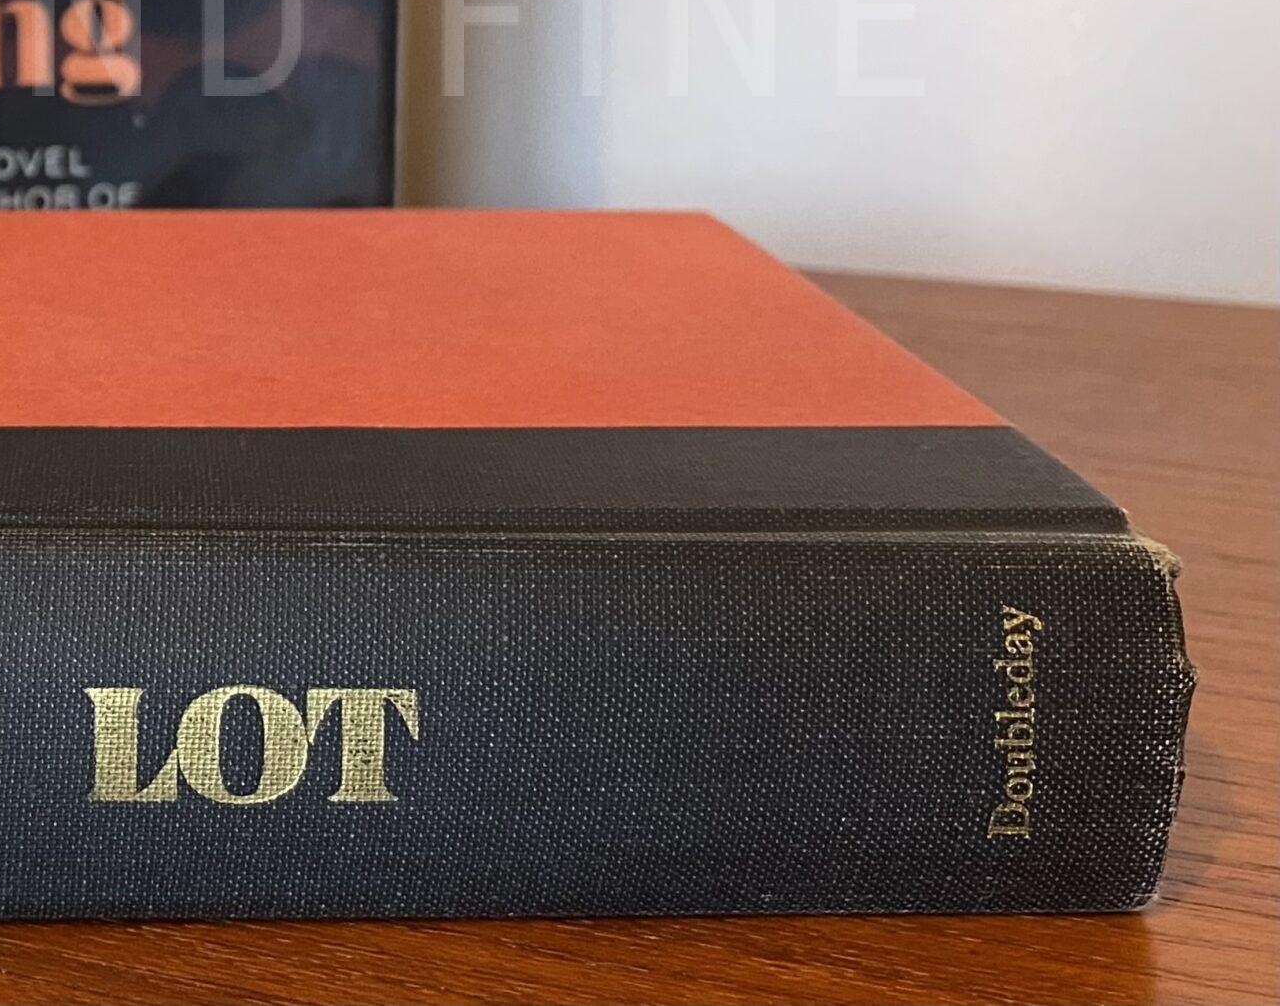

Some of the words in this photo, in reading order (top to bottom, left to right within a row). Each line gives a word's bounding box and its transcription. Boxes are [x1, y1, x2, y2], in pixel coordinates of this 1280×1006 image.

[87, 181, 142, 209] OF
[85, 683, 419, 806] LOT
[987, 604, 1043, 839] Doubleday
